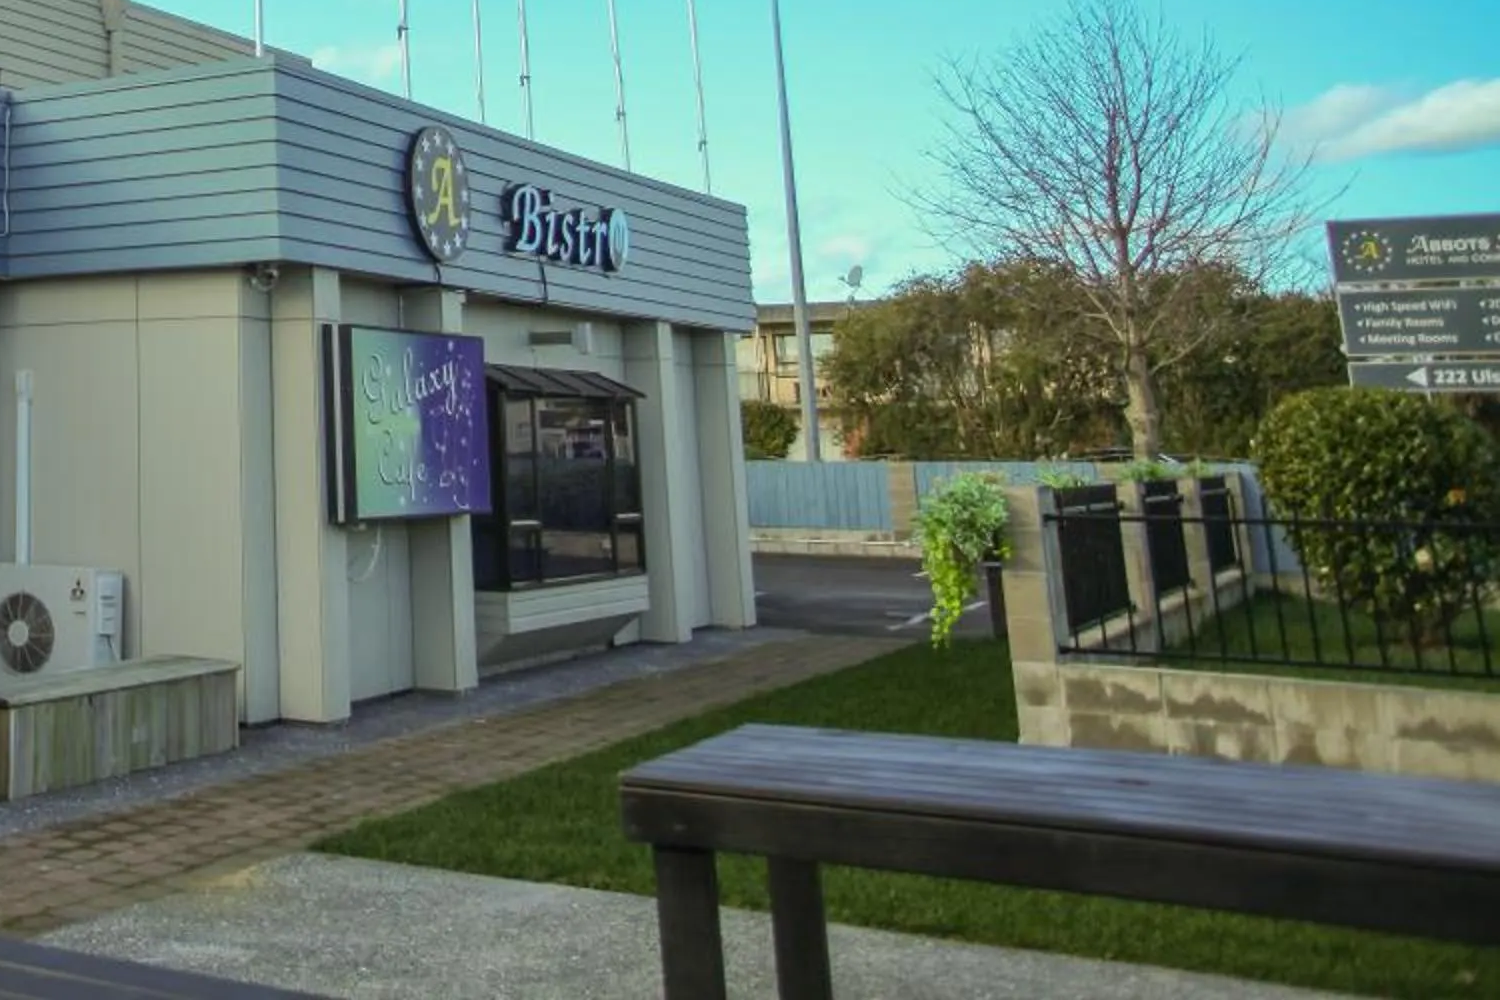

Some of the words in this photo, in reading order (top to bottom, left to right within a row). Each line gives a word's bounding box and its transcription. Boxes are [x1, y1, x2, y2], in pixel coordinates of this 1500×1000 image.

[427, 157, 460, 227] A
[510, 183, 628, 272] Bistro
[1365, 317, 1402, 329] Family
[1367, 334, 1416, 346] Meeting
[1417, 333, 1458, 344] Rooms
[362, 347, 458, 425] Galaxy
[1433, 369, 1467, 384] 222
